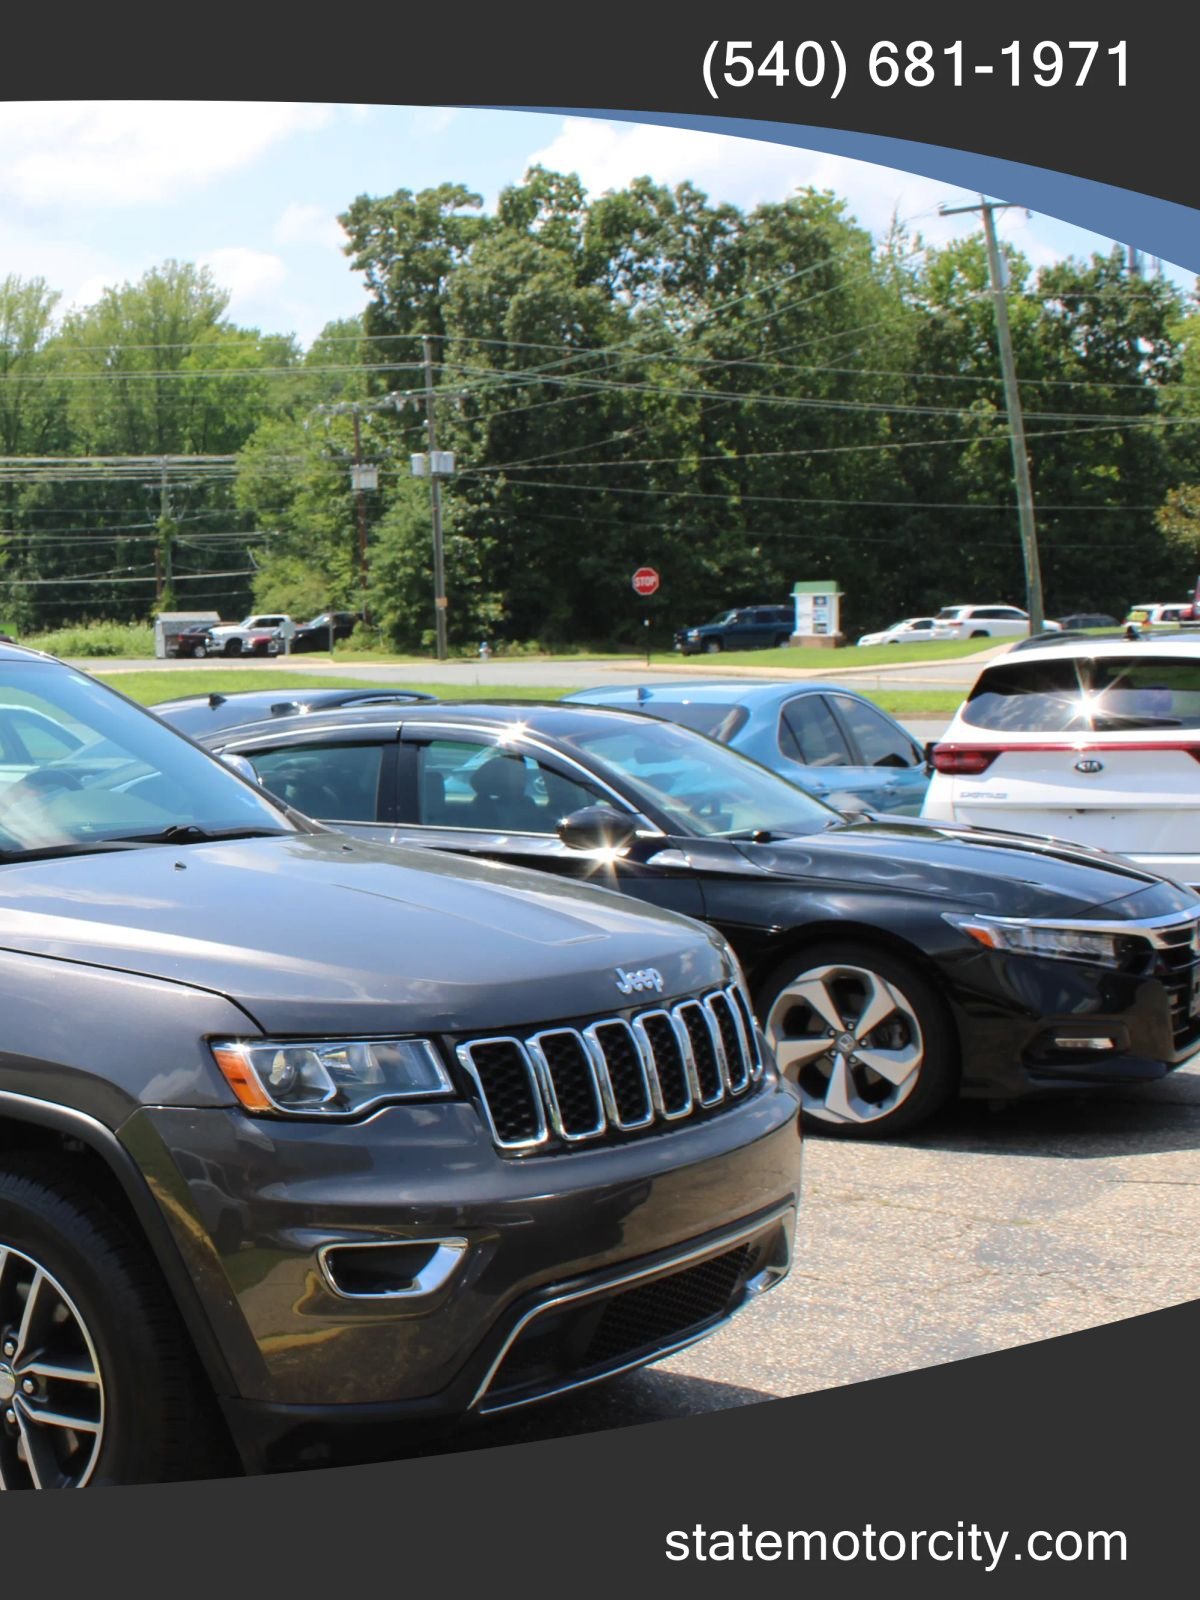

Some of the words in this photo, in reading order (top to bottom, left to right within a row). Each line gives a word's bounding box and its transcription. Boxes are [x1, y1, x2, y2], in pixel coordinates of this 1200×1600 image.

[635, 576, 656, 587] STOP
[1079, 762, 1100, 773] KIA
[615, 967, 664, 994] Jeep
